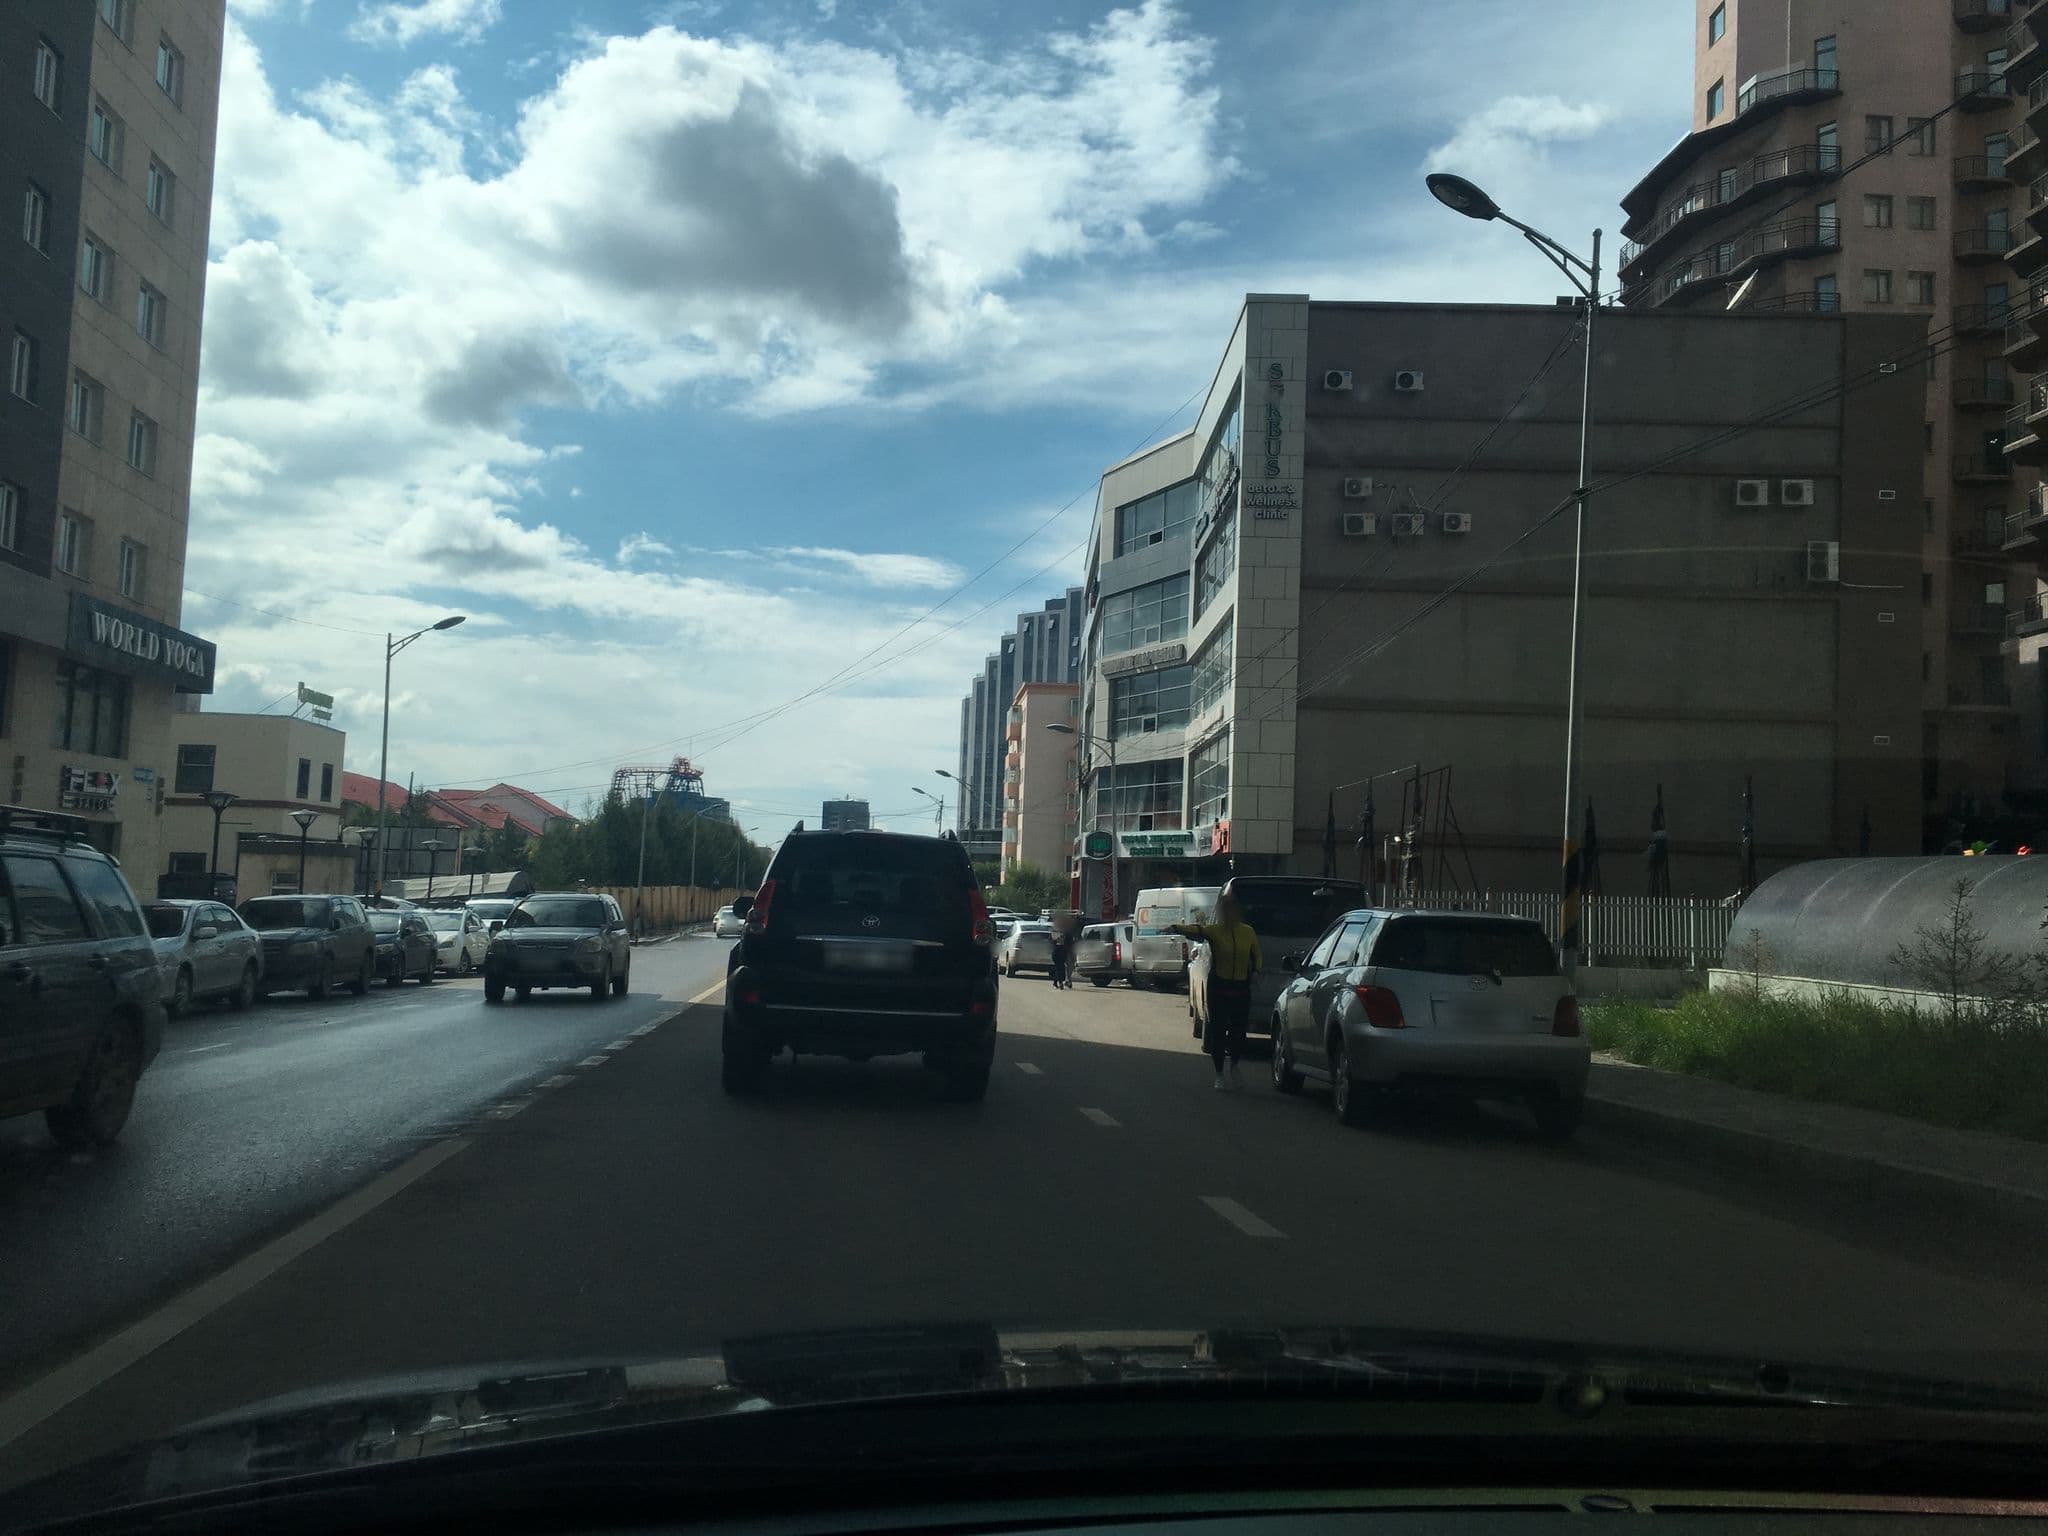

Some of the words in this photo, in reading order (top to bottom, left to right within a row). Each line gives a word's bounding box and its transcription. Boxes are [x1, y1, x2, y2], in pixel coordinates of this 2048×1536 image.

[1286, 482, 1297, 493] &
[1255, 509, 1288, 520] clinic
[93, 610, 160, 660] WORLD
[164, 638, 205, 677] YOGA
